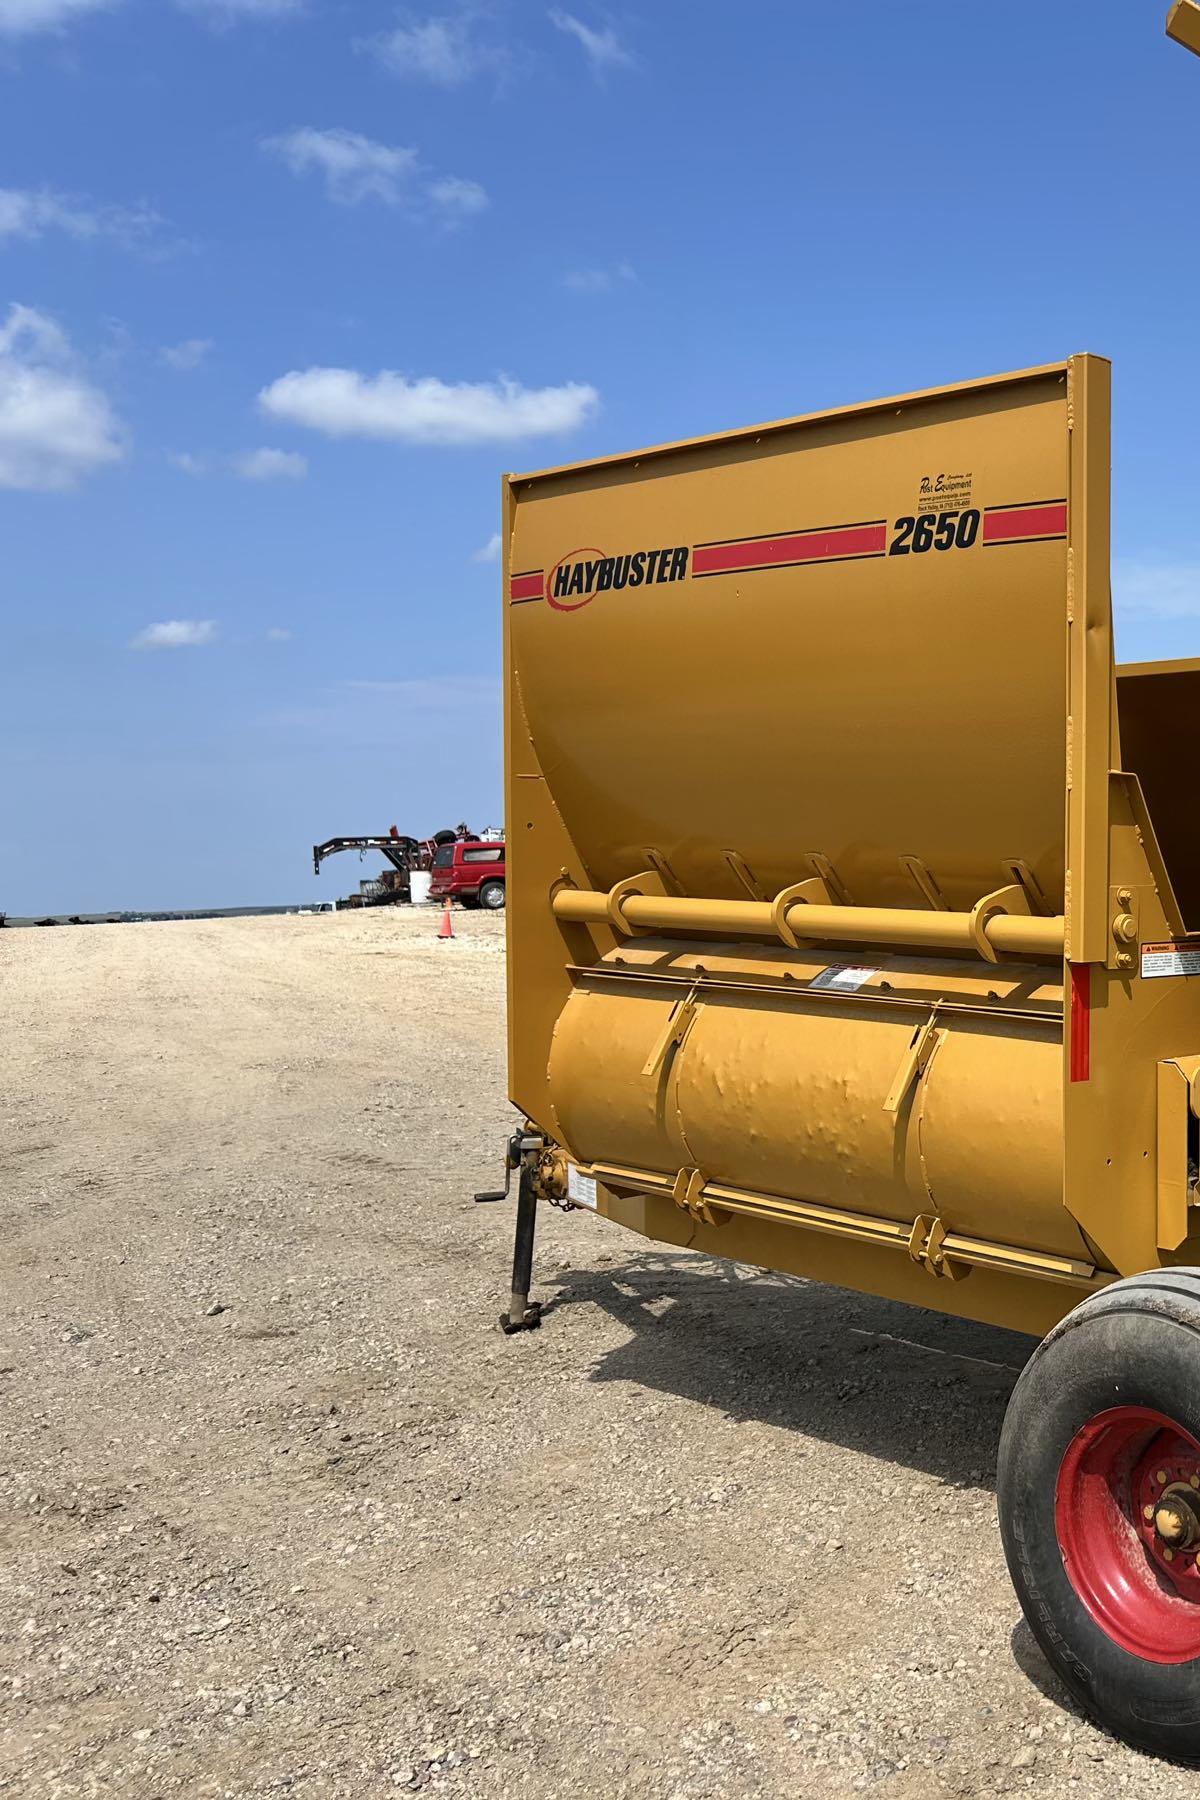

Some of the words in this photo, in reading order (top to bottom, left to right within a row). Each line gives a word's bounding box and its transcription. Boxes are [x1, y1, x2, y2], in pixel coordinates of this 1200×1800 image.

[919, 476, 933, 494] Post
[934, 473, 972, 493] Equipment
[889, 509, 980, 555] 2650
[553, 546, 689, 598] HAYBUSTER
